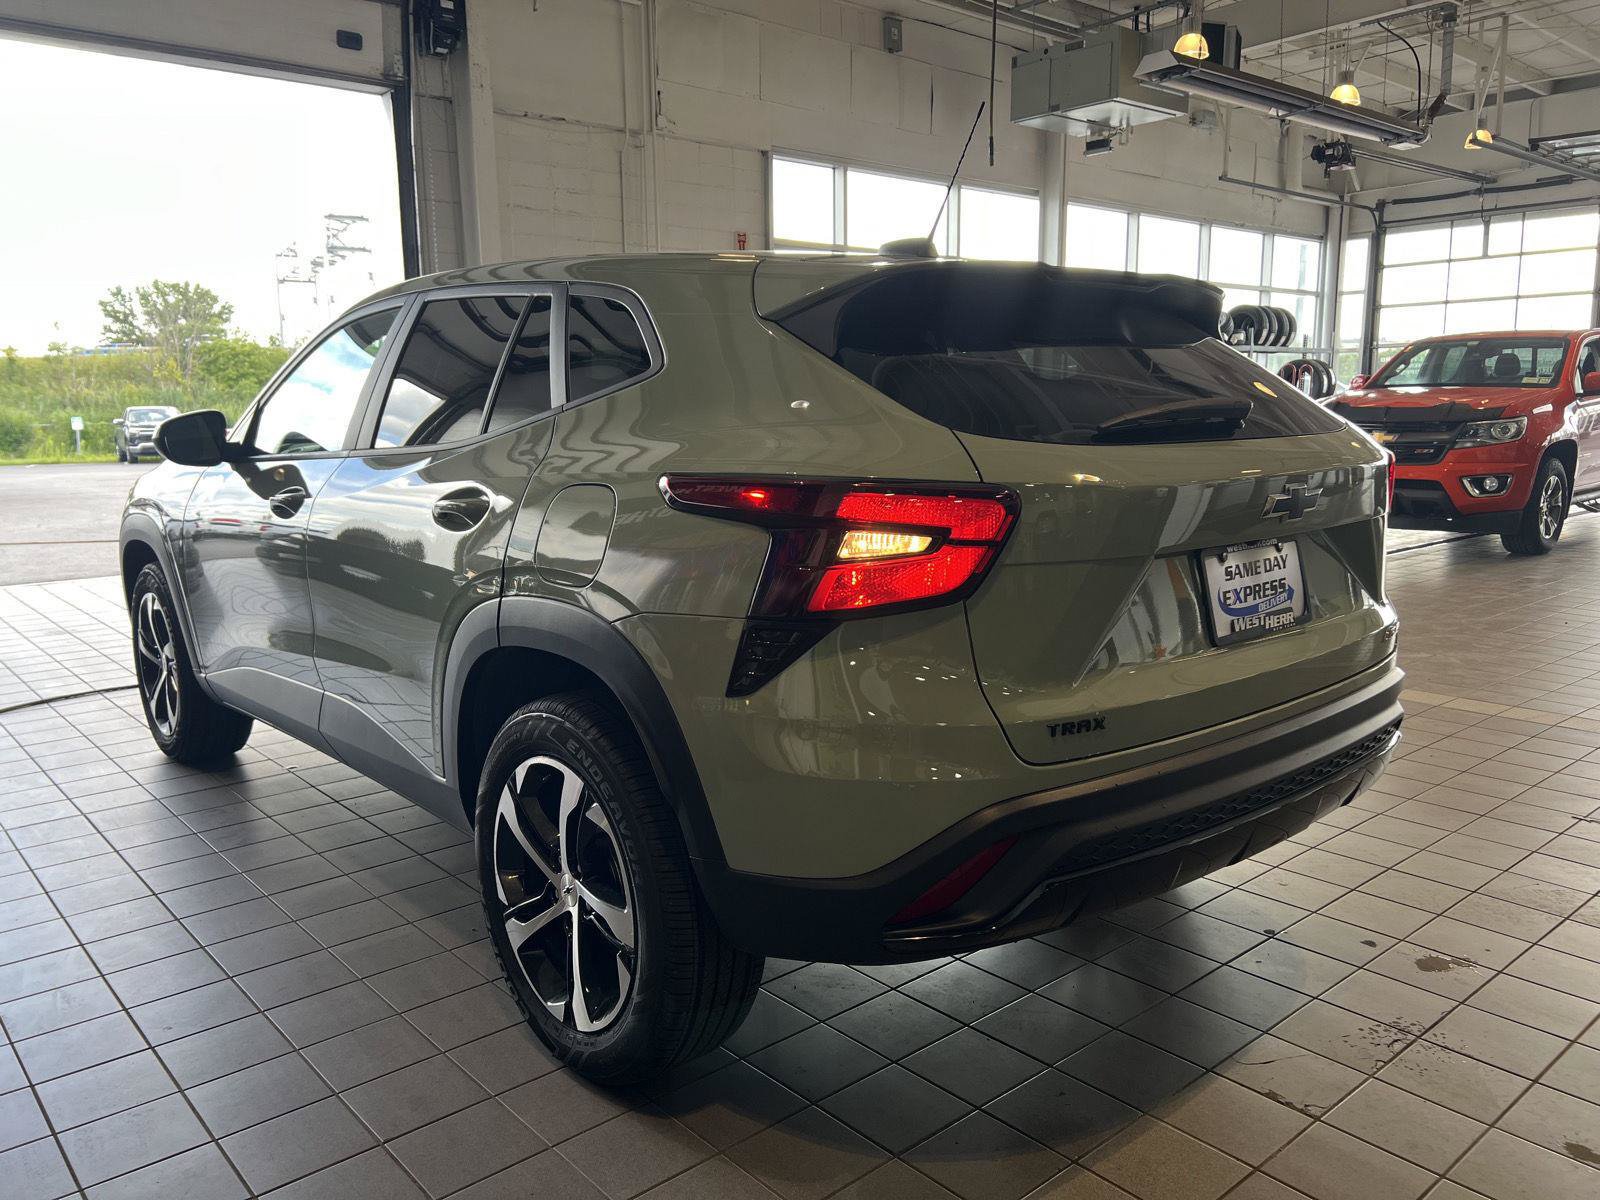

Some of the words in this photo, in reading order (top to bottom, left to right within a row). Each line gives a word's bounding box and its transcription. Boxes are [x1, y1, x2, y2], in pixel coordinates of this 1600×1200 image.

[1224, 560, 1261, 582] SAME
[1264, 554, 1288, 574] DAY
[1222, 577, 1287, 607] EXPRESS
[1258, 592, 1288, 611] DELIVERY
[1233, 614, 1266, 632] WEST
[1265, 611, 1295, 629] HERR
[1046, 716, 1106, 738] TRAX
